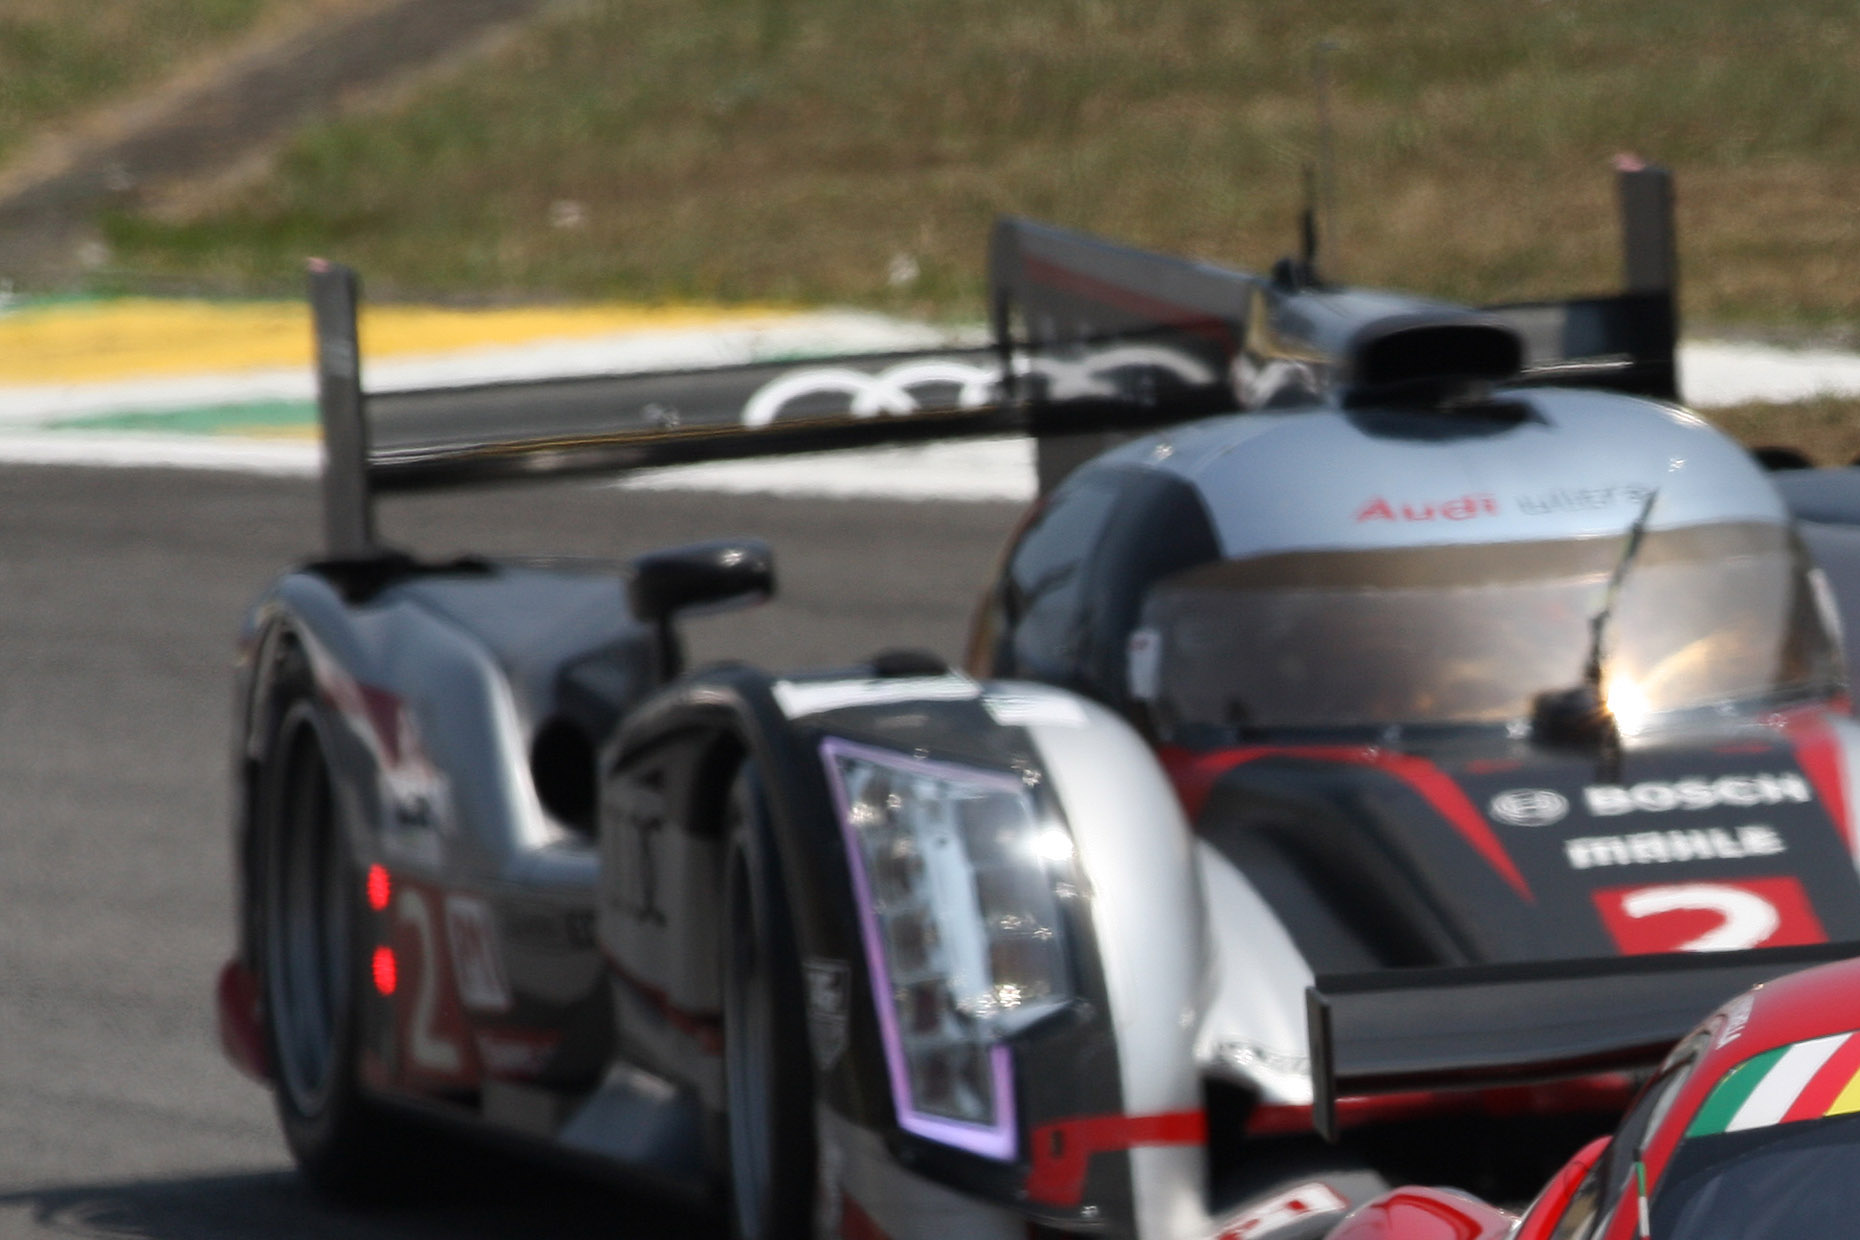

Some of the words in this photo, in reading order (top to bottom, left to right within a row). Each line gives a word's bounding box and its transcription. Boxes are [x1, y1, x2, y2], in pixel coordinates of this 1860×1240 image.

[1354, 493, 1497, 522] Audi
[1584, 772, 1811, 816] BOSCH
[1565, 825, 1786, 869] MAHLE
[1621, 883, 1781, 952] 2
